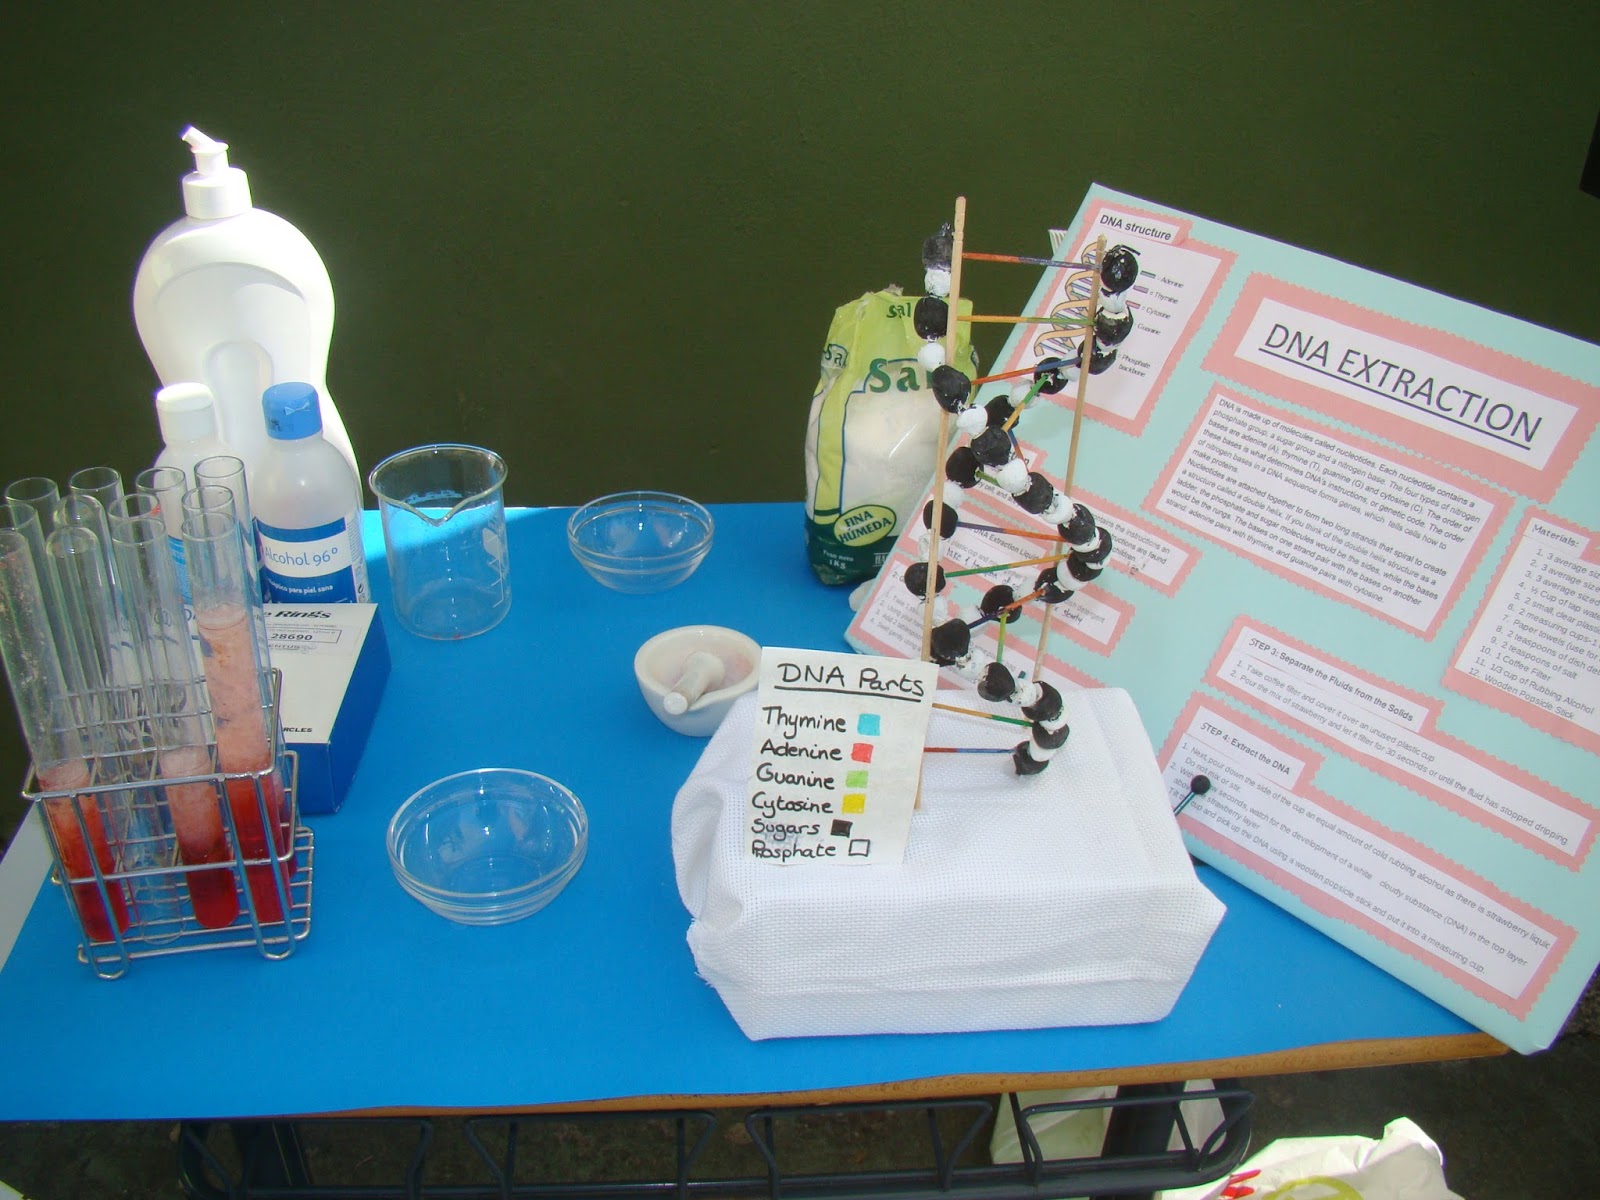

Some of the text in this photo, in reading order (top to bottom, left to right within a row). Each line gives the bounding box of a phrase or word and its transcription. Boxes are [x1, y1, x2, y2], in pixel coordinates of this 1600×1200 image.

[1100, 214, 1172, 241] DNA structure
[886, 302, 912, 318] sal
[1264, 323, 1542, 443] DNA EXTRACTION
[1217, 398, 1236, 410] DNA
[1241, 408, 1262, 421] made
[1278, 423, 1314, 442] molecules
[1313, 437, 1336, 451] called
[1377, 463, 1399, 477] Each
[1397, 472, 1437, 492] nucleotide
[1435, 488, 1469, 505] contains
[844, 510, 874, 527] FINA
[988, 534, 1020, 553] Extraction
[1126, 528, 1160, 550] instructions
[1532, 524, 1579, 548] Materials:
[265, 546, 310, 566] Alcohol
[304, 586, 316, 595] piel
[274, 610, 332, 618] Rings
[777, 662, 924, 697] DNA Parts
[1247, 637, 1271, 653] STEP
[1278, 651, 1315, 674] Separate
[1313, 668, 1329, 680] the
[1327, 675, 1355, 693] Fluids
[1353, 687, 1374, 702] from
[1372, 697, 1388, 709] the
[1386, 703, 1415, 722] Solids
[1489, 662, 1504, 674] 1/3
[1501, 669, 1519, 682] cup
[1527, 680, 1563, 702] Rubbing
[1562, 695, 1595, 715] Alcohol
[1483, 674, 1518, 694] Wooden
[1518, 689, 1554, 711] Popsicle
[1554, 705, 1575, 720] Stick
[762, 706, 847, 740] Thymine
[760, 738, 843, 761] Adenine
[1200, 721, 1223, 738] STEP
[1229, 737, 1259, 757] Extract
[1257, 752, 1272, 765] the
[1271, 760, 1291, 775] DNA
[756, 762, 835, 790] Guanine
[752, 791, 834, 818] Cytosine
[751, 818, 820, 842] Sugars
